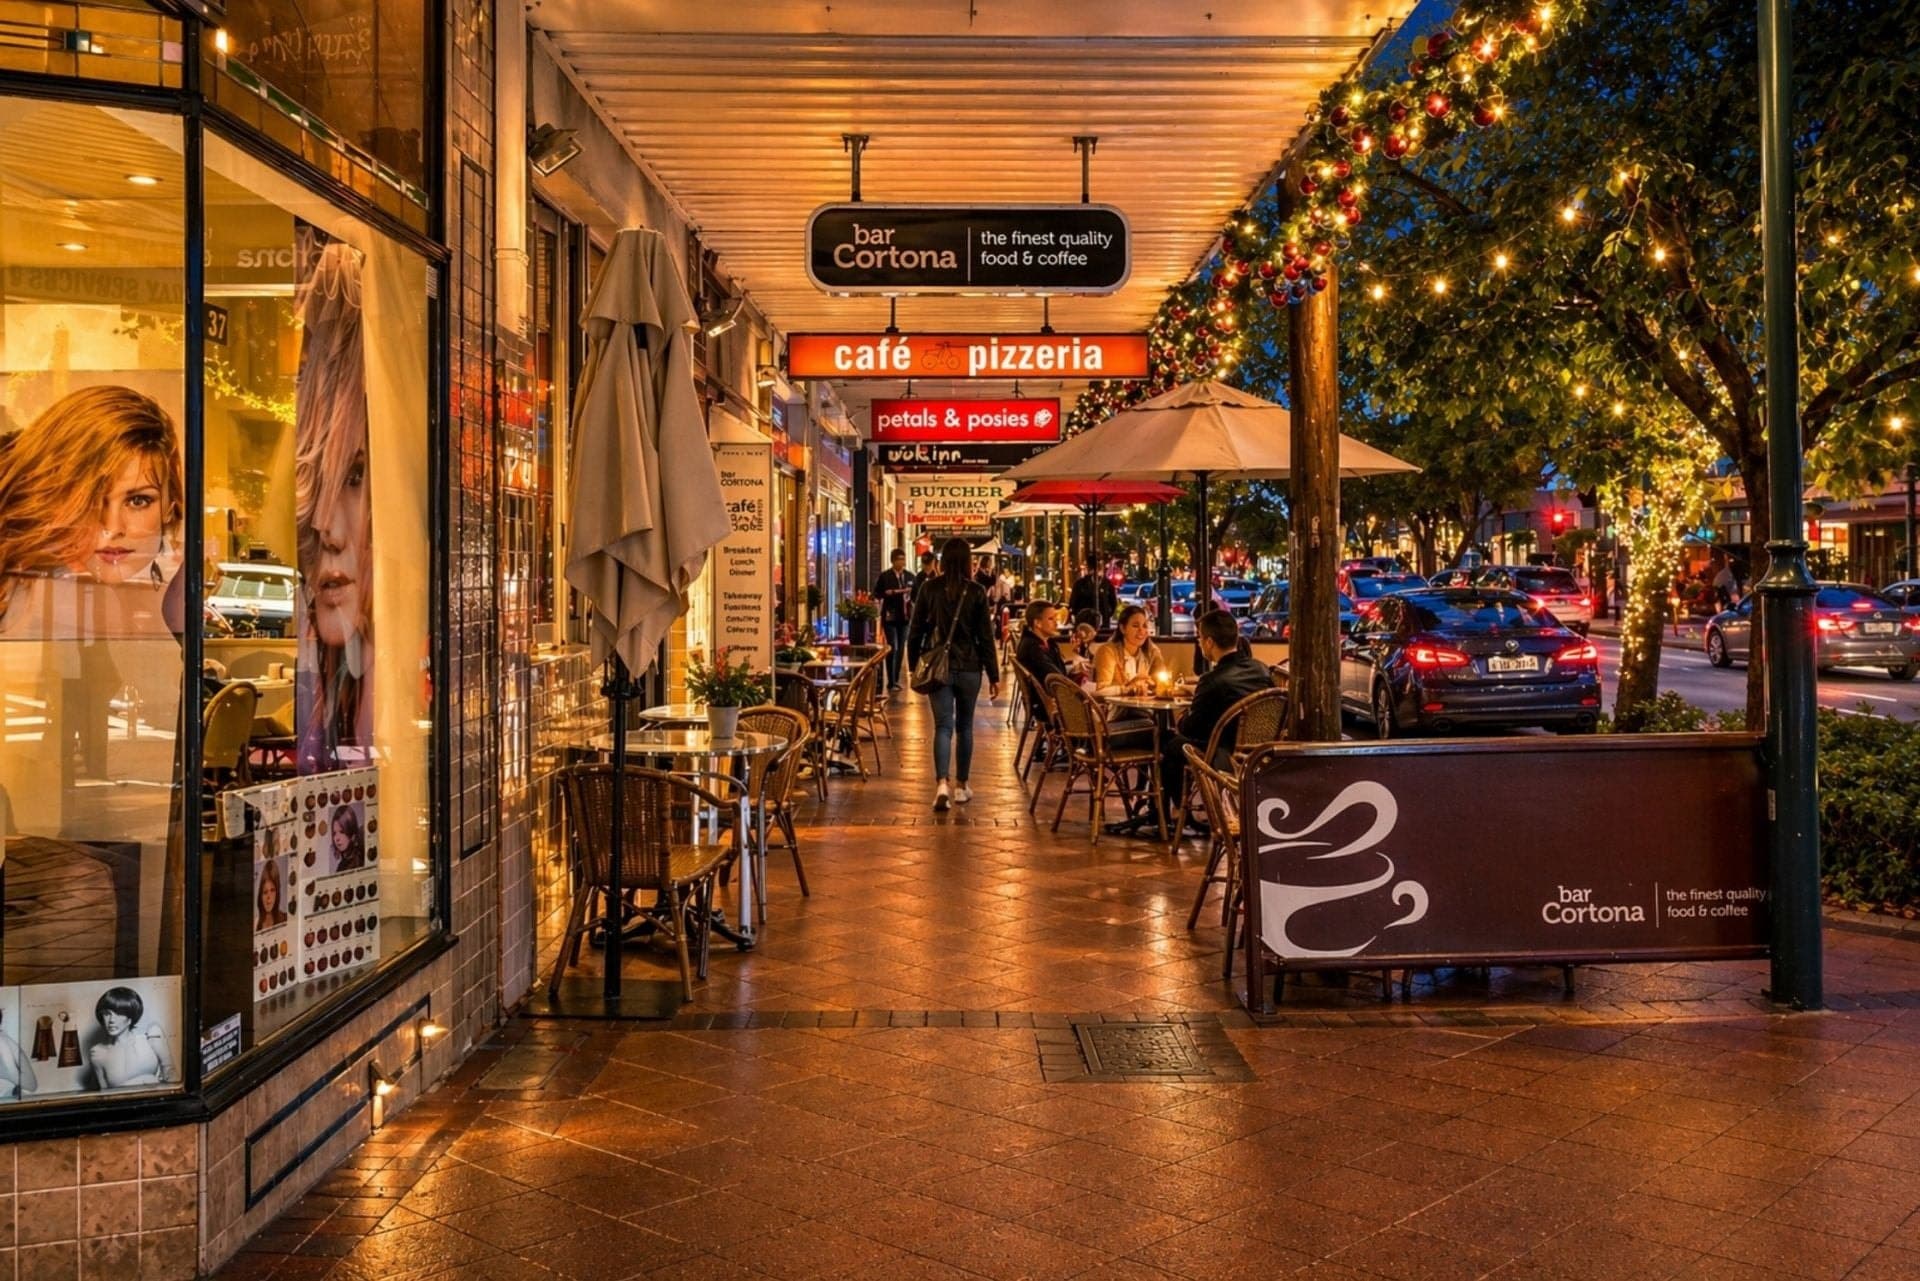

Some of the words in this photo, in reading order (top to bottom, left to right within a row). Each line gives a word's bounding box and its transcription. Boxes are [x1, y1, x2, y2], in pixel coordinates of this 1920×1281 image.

[852, 223, 895, 245] bar
[981, 230, 1007, 246] the
[1011, 230, 1055, 246] finest
[1059, 231, 1112, 249] quality
[833, 243, 958, 269] Cortona
[981, 250, 1018, 266] food
[1023, 250, 1034, 266] &
[1037, 250, 1088, 266] coffee
[834, 337, 911, 370] café
[968, 337, 1102, 376] pizzeria
[878, 408, 937, 432] petals
[944, 408, 961, 427] &
[968, 408, 1028, 431] posies
[910, 486, 1003, 497] BUTCHER
[1557, 885, 1592, 902] bar
[1666, 889, 1687, 901] the
[1689, 889, 1724, 901] finest
[1727, 887, 1768, 904] quality
[1542, 902, 1646, 924] Cortona
[1667, 905, 1696, 918] food
[1698, 905, 1707, 917] &
[1710, 905, 1748, 917] coffee
